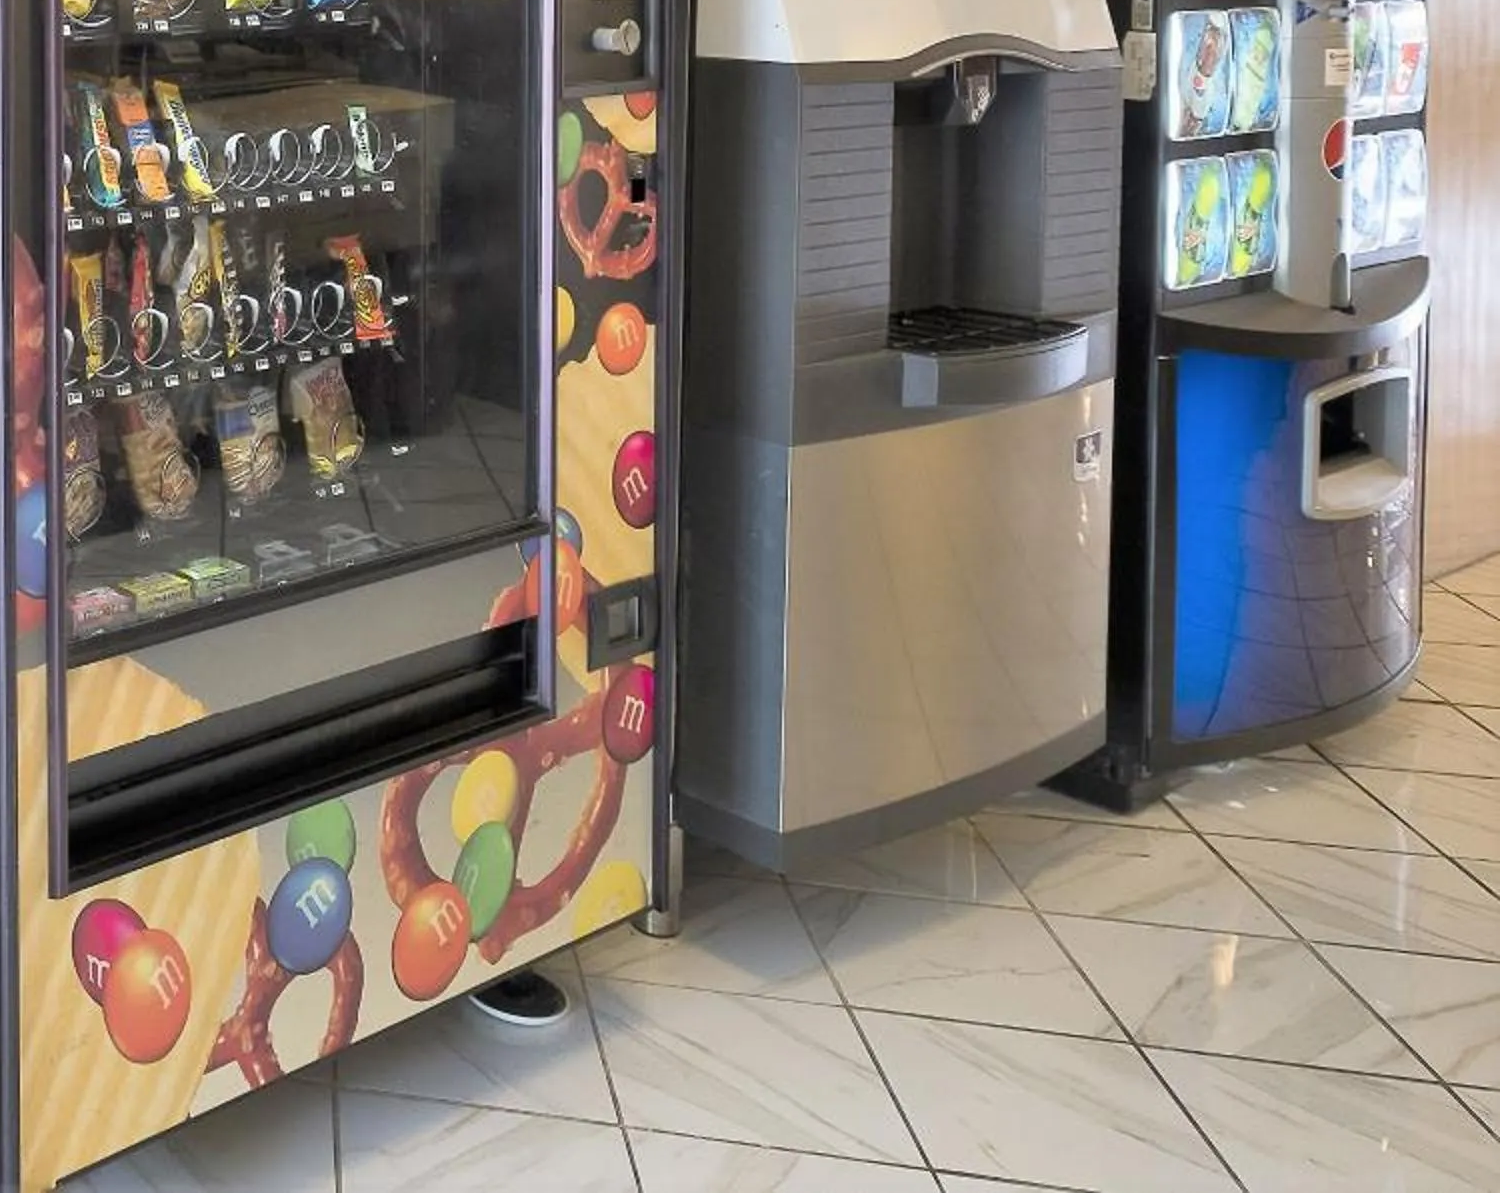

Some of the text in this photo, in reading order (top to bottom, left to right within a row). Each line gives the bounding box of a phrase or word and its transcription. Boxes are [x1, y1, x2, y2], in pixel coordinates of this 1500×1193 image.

[614, 316, 640, 350] m
[620, 464, 648, 508] m
[619, 694, 646, 734] m
[295, 877, 336, 930] m
[430, 899, 464, 947] m
[148, 953, 186, 1010] m
